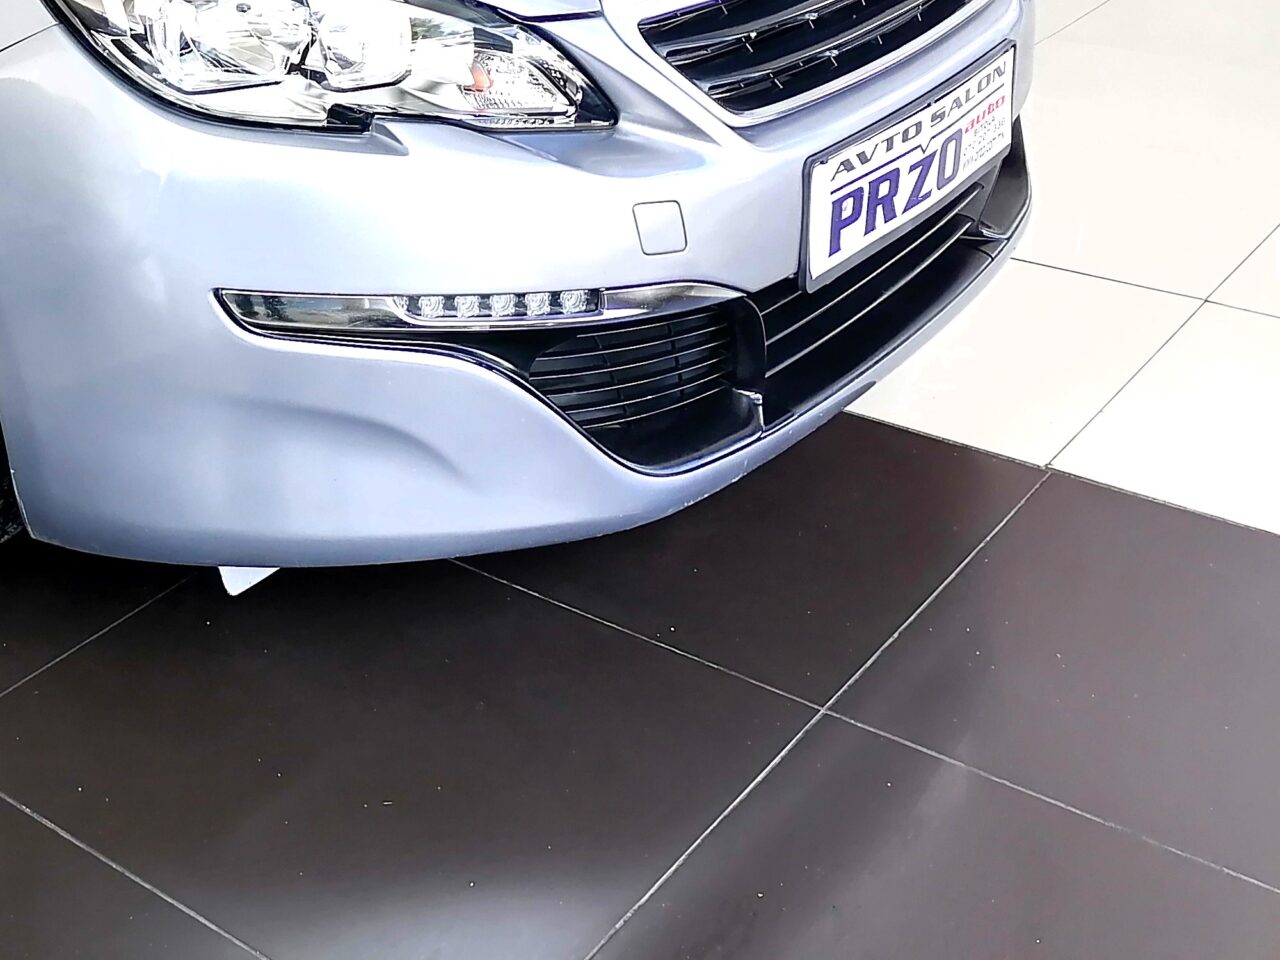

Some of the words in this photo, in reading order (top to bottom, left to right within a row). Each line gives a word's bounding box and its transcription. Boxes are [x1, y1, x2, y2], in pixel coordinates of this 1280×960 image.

[830, 120, 923, 182] AVTO
[930, 60, 1007, 128] SALON
[964, 95, 1006, 134] auto
